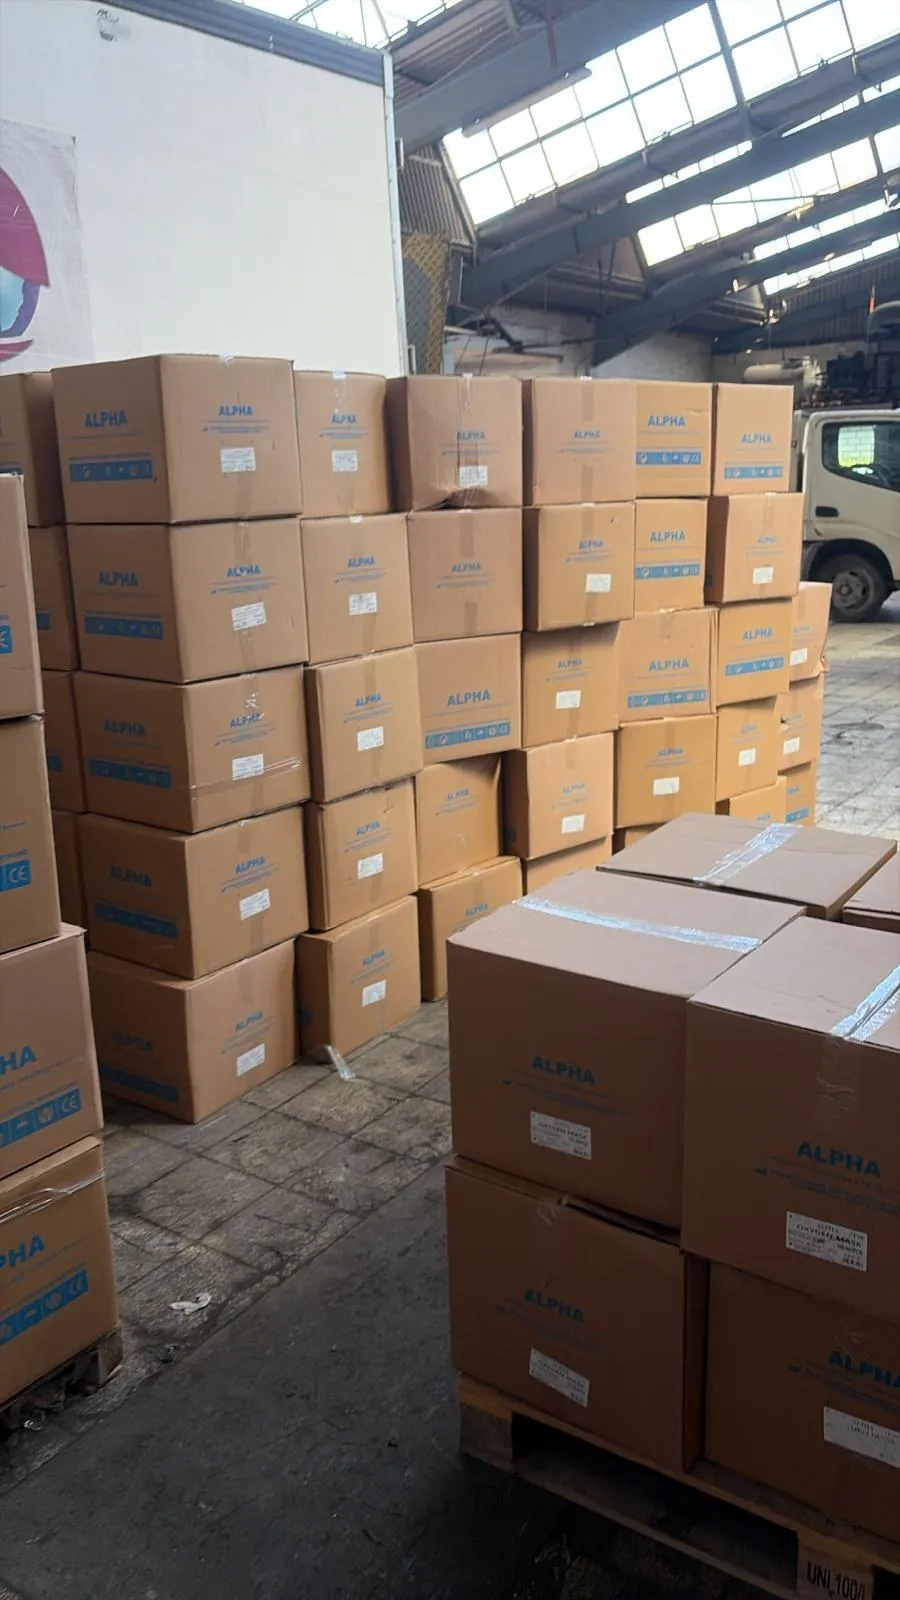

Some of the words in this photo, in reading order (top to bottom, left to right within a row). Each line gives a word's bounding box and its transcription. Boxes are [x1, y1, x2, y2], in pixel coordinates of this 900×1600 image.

[218, 405, 254, 417] ALPHA
[85, 410, 128, 429] ALPHA
[647, 415, 686, 427] ALPHA
[574, 430, 601, 440] ALPHA
[741, 433, 772, 444] ALPHA
[650, 530, 686, 543] ALPHA
[578, 539, 604, 550] ALPHA
[227, 564, 261, 577] ALPHA
[98, 571, 139, 587] ALPHA
[742, 627, 773, 641] ALPHA
[557, 657, 583, 669] ALPHA
[649, 658, 690, 672] ALPHA
[447, 689, 491, 707] ALPHA
[104, 718, 147, 737] ALPHA
[235, 856, 266, 873] ALPHA
[532, 1056, 595, 1085] ALPHA
[796, 1141, 882, 1178] ALPHA
[525, 1288, 584, 1322] ALPHA
[807, 1562, 831, 1590] UNI
